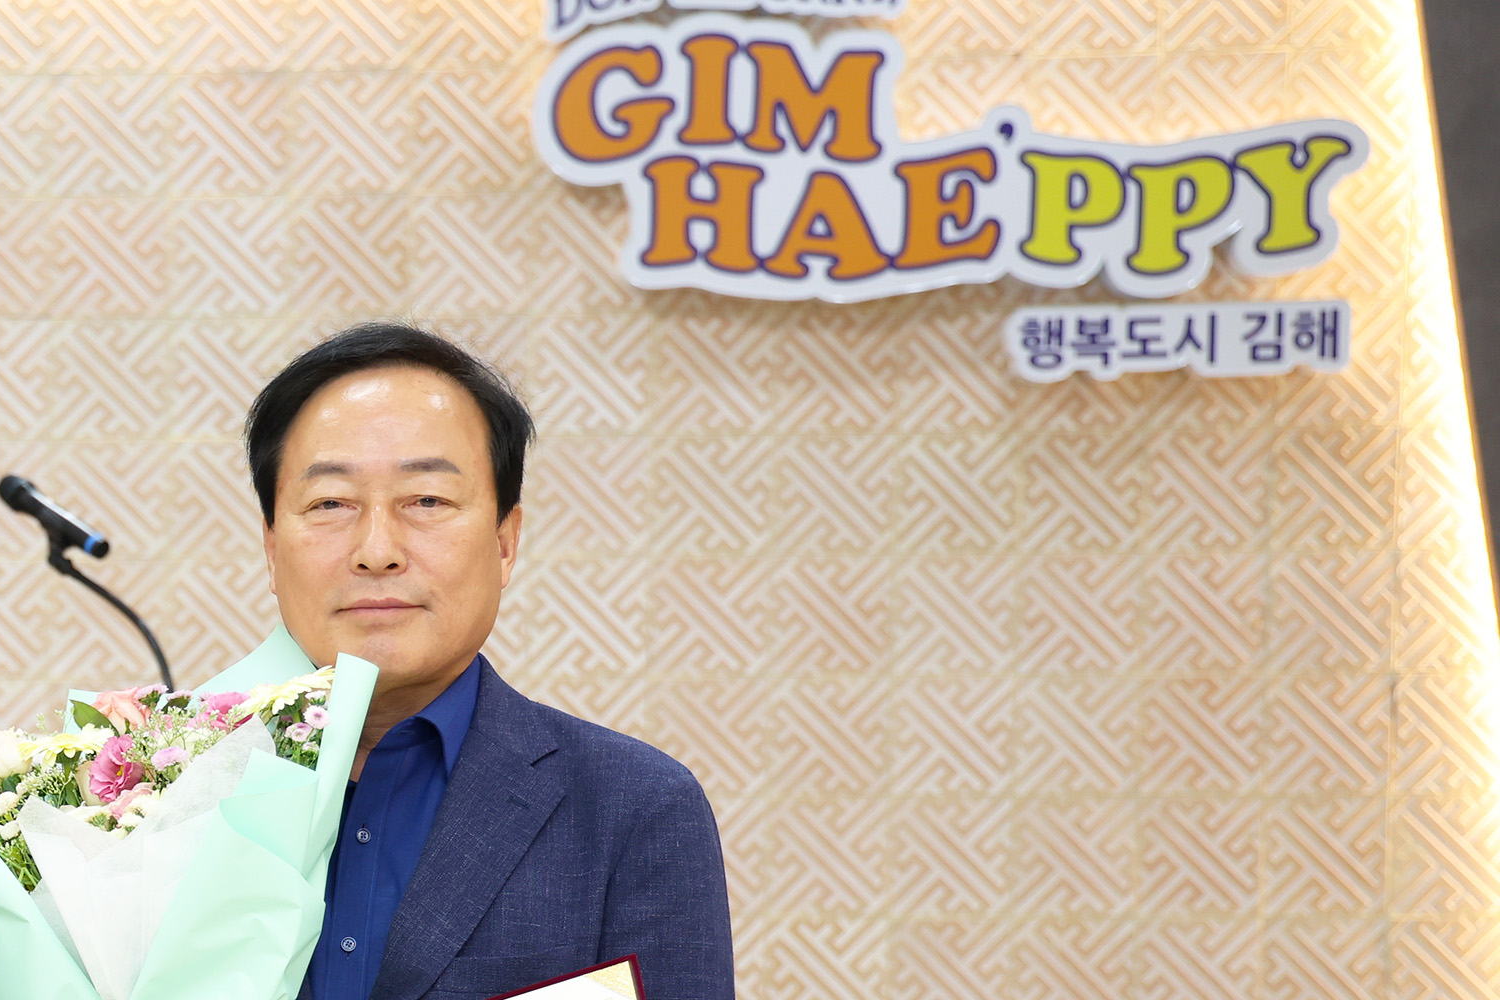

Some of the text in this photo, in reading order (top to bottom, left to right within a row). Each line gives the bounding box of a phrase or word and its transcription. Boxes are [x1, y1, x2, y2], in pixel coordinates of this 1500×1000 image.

[551, 32, 886, 163] GIM
[1020, 308, 1339, 369] 행복도시 김해
